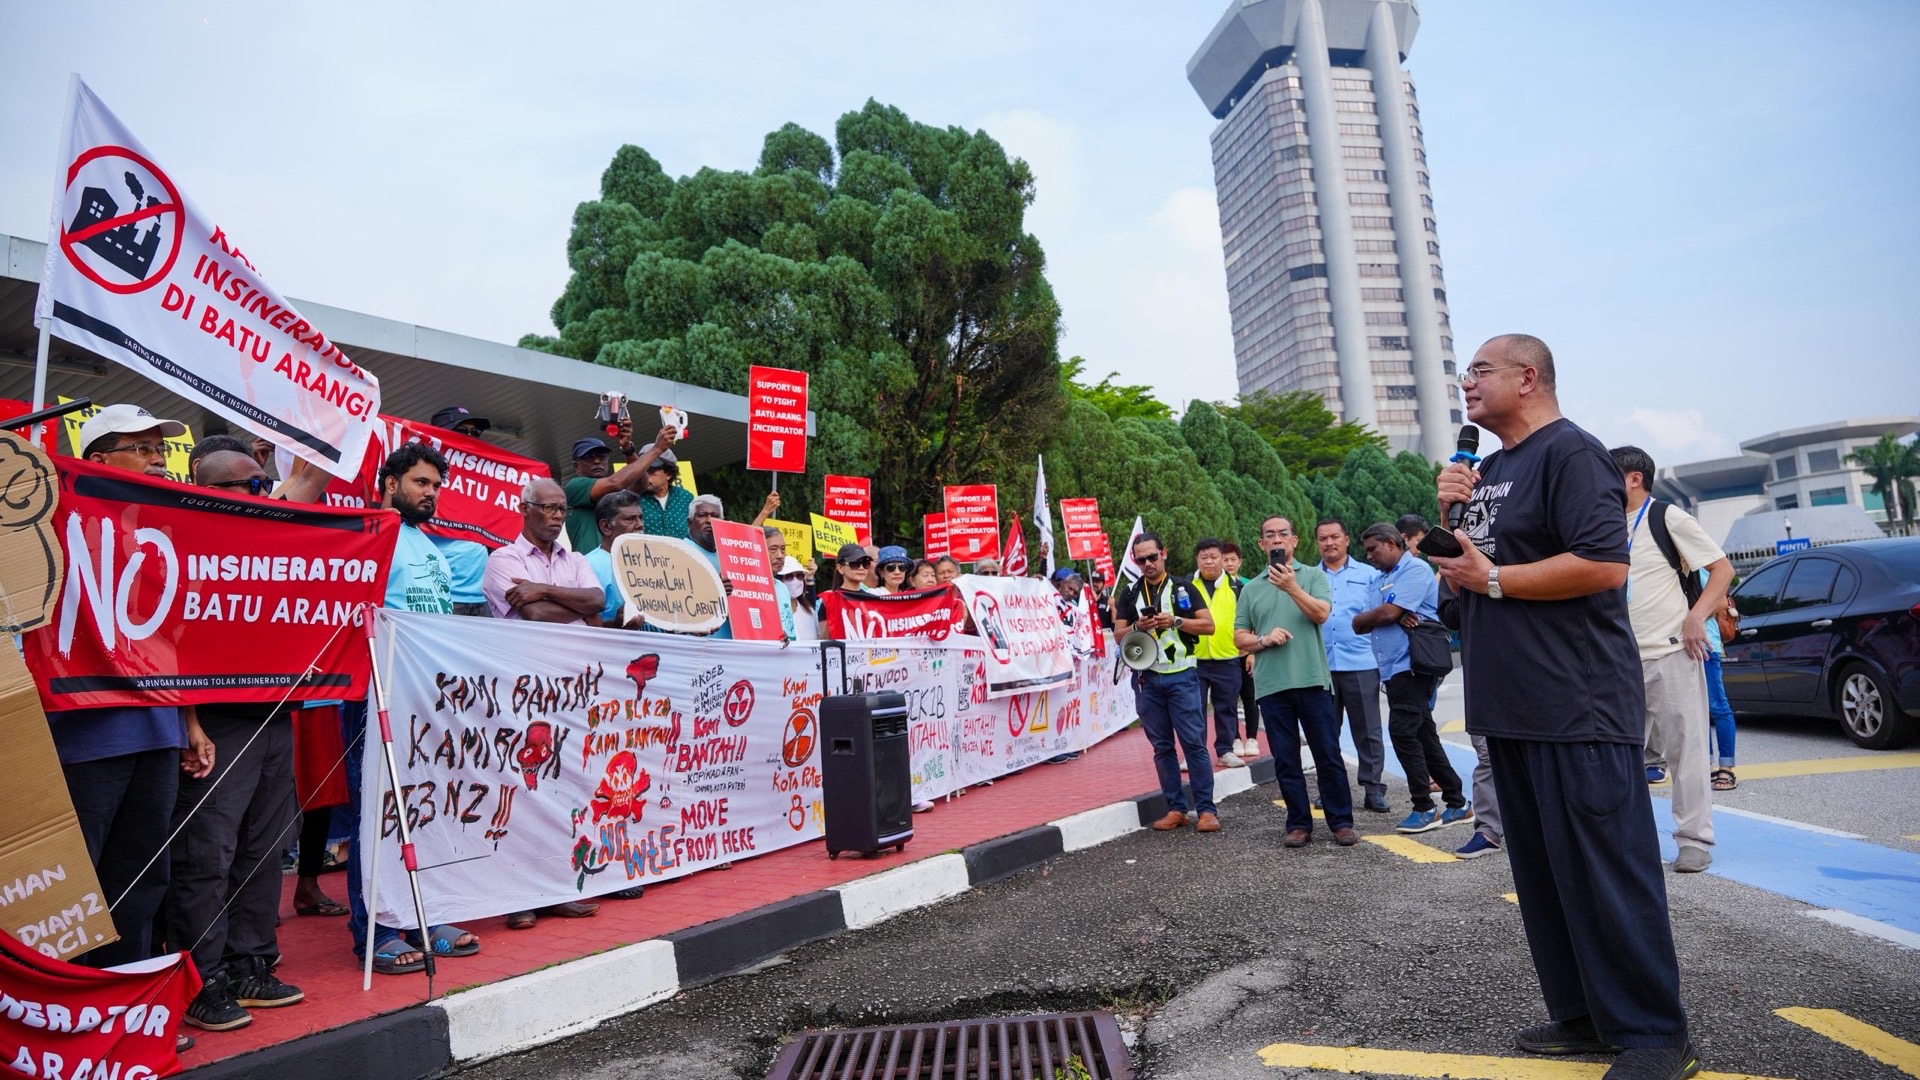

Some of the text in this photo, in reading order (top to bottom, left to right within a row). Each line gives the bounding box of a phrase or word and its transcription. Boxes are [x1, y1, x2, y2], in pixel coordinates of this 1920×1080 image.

[160, 283, 374, 423] DI BATU ARANG!
[124, 338, 278, 428] JARINGAN RAWANG TOLAK INSINERATOR
[757, 381, 802, 393] SUPPORT US
[761, 395, 797, 407] TO FIGHT
[755, 409, 801, 422] BATU ARANG
[752, 423, 804, 436] INCINERATOR
[829, 486, 857, 495] SUPPORT
[834, 497, 863, 506] TO FIGHT
[950, 495, 981, 503] SUPPORT
[180, 496, 295, 519] TOGETHER WE FIGHT
[829, 509, 867, 518] BATU ARANG
[967, 505, 987, 513] FIGHT
[823, 521, 843, 535] AIR
[950, 527, 997, 535] INCINERATOR
[720, 537, 763, 553] SUPPORT US
[1779, 542, 1808, 552] PINTU
[728, 554, 761, 568] TO FIGHT
[187, 554, 378, 583] INSINERATOR
[726, 570, 770, 586] BATU ARANG
[58, 510, 180, 661] NO
[406, 595, 437, 604] RAWANG
[731, 588, 775, 602] NCINERATOR
[183, 591, 263, 622] BATU
[407, 603, 440, 614] TOLAK
[841, 607, 887, 639] NO
[137, 677, 291, 687] JARINGAN RAWANG TOLAK INSINERATOR
[435, 662, 604, 721] KAMI BANTAH
[693, 680, 722, 704] #WTE
[408, 714, 491, 770] KAMI
[680, 797, 729, 837] MOVE
[597, 820, 630, 865] NO
[673, 826, 756, 868] FROM HERE
